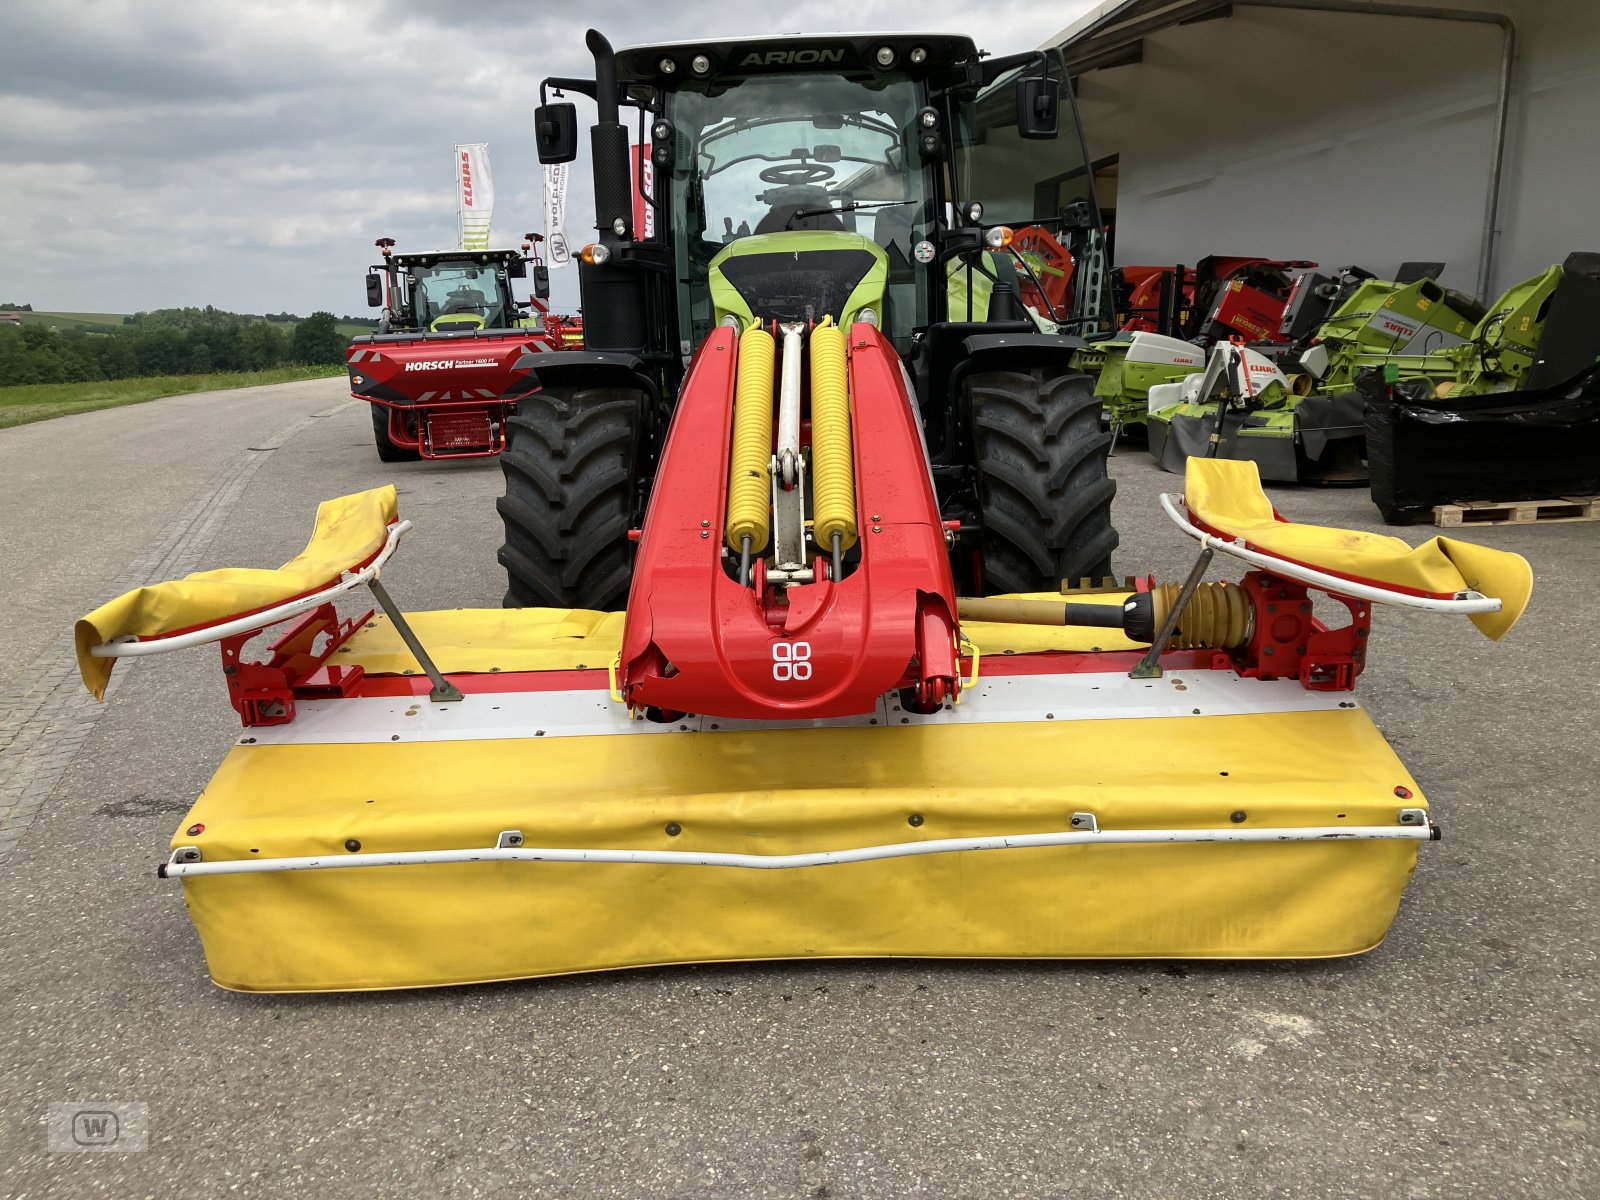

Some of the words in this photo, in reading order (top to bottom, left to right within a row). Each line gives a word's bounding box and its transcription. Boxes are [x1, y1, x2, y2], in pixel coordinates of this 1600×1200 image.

[738, 48, 846, 66] ARION
[461, 151, 473, 207] CLAAS
[1383, 321, 1414, 337] CLAAS
[404, 360, 454, 372] HORSCH
[1173, 357, 1194, 365] CLAAS
[1250, 365, 1278, 374] CLAAS
